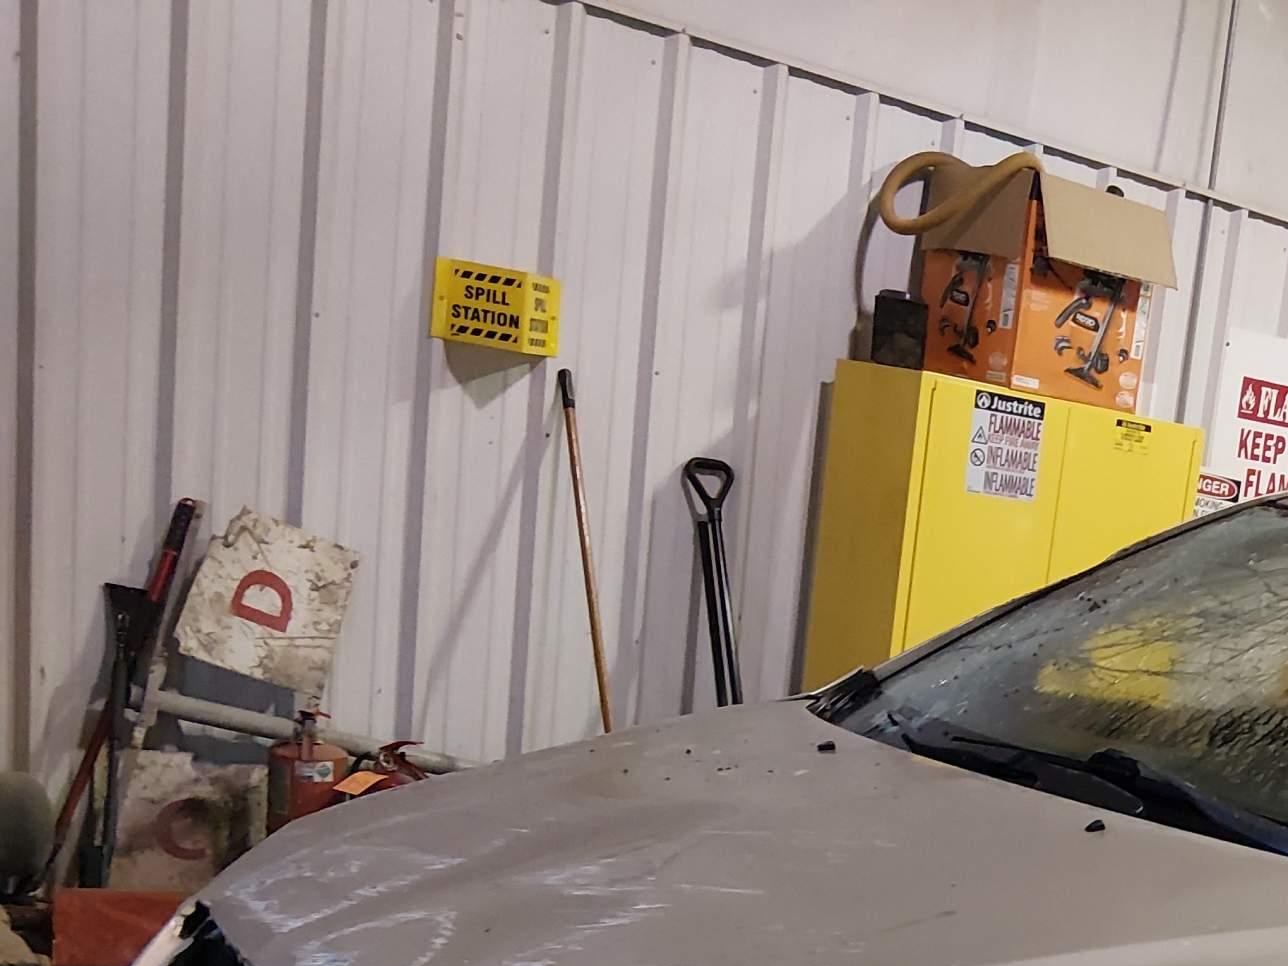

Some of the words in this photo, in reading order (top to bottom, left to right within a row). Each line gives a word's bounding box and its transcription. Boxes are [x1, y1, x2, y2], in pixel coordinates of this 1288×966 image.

[464, 285, 510, 306] SPILL
[451, 304, 520, 329] STATION
[991, 395, 1042, 418] Justrite
[988, 413, 1042, 441] FLAMMABLE
[1237, 428, 1286, 465] KEEP
[231, 569, 293, 632] D
